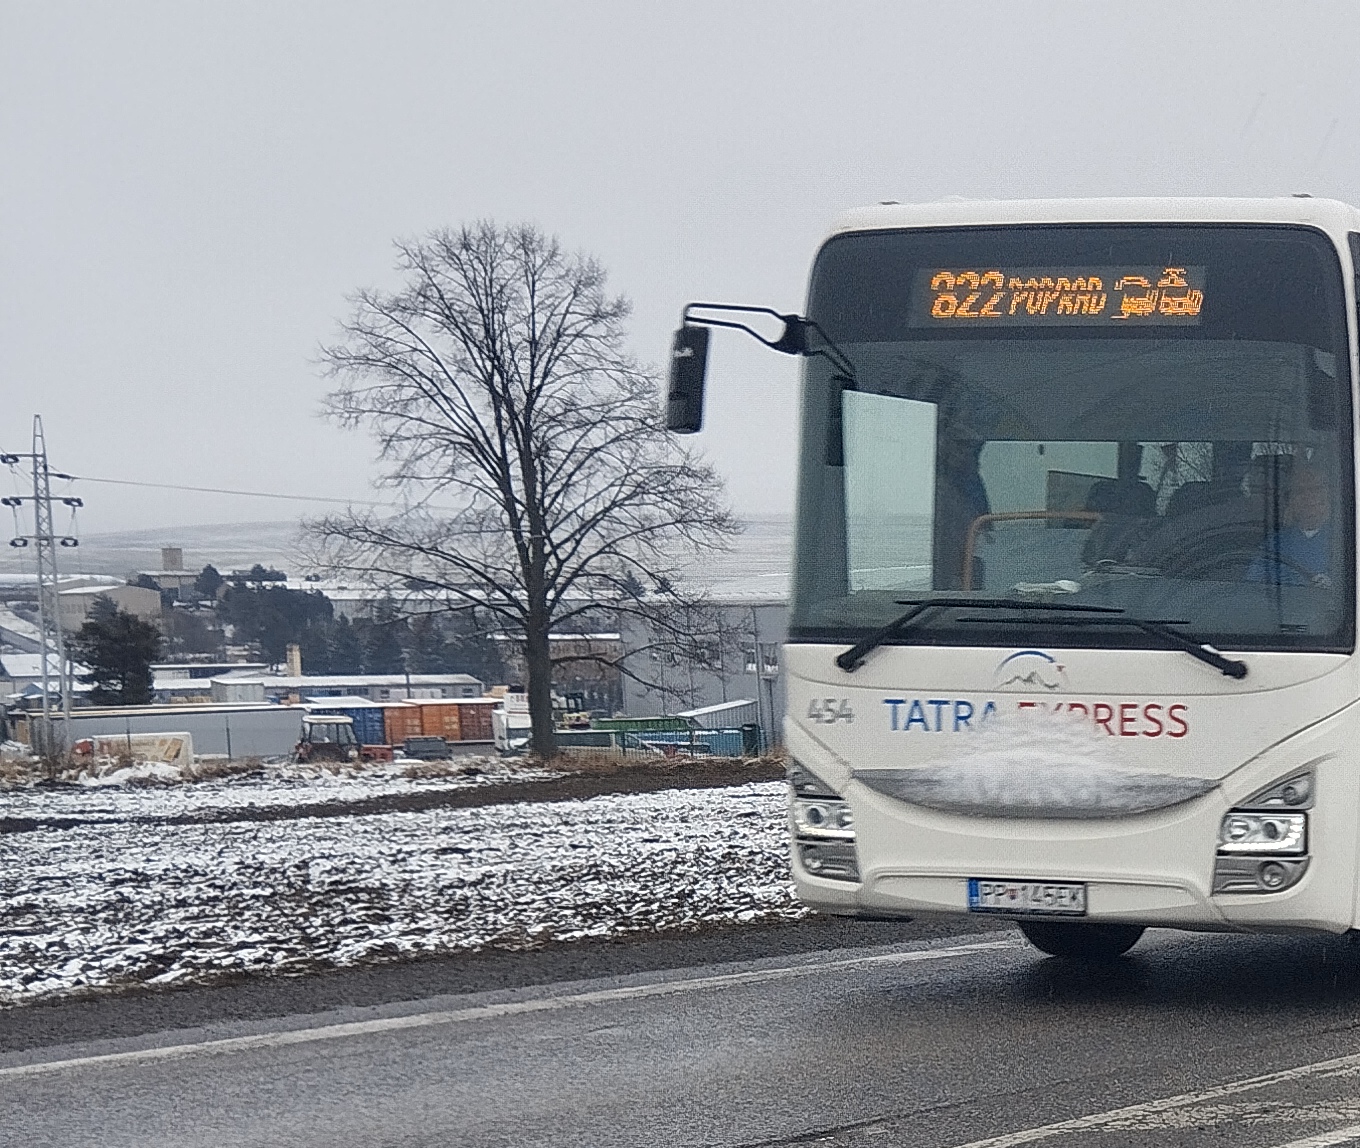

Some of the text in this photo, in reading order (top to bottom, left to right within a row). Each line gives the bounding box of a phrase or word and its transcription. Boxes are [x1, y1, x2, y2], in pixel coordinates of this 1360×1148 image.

[930, 271, 1107, 318] 822 POPRAD
[808, 699, 855, 724] 454
